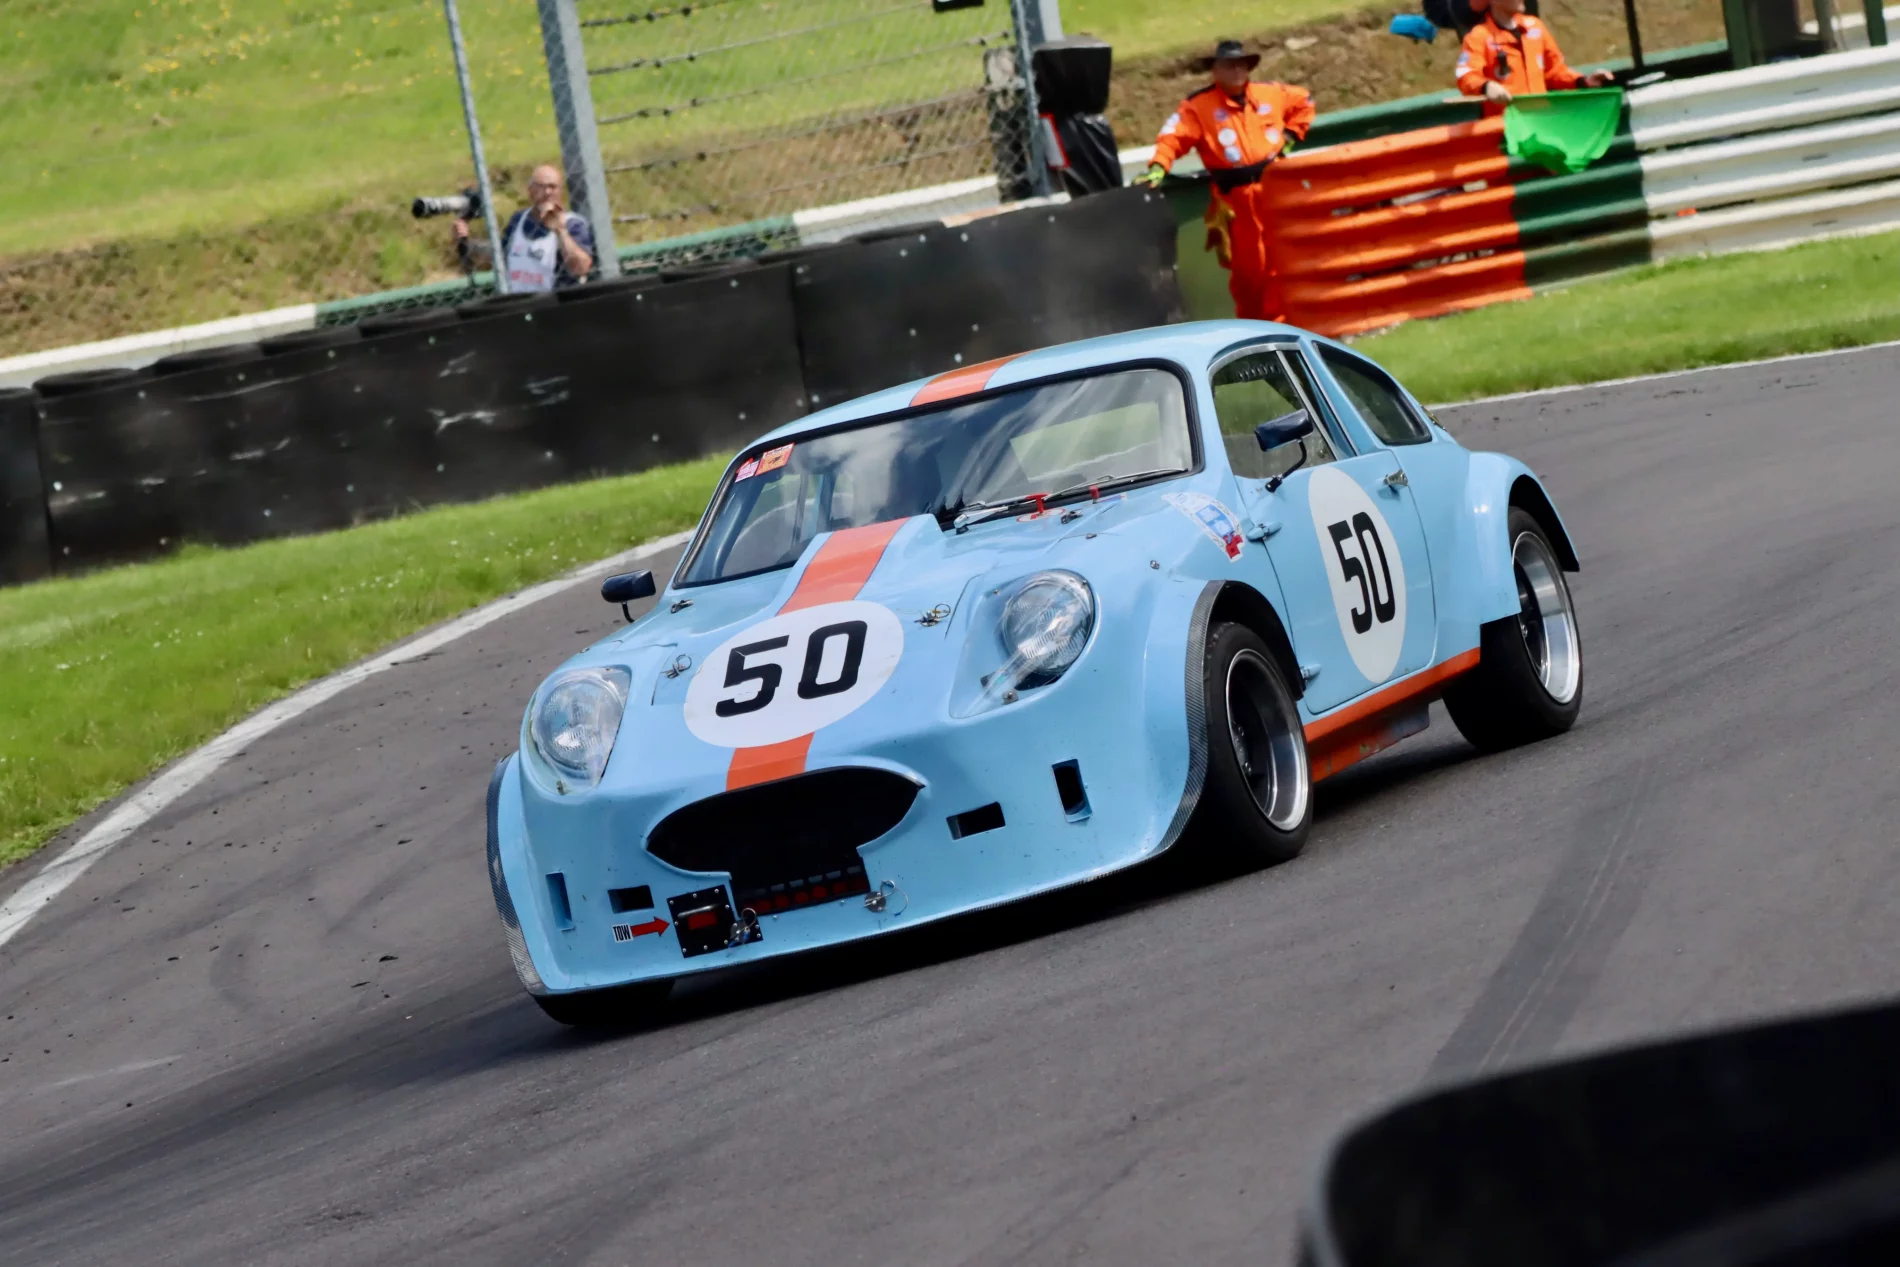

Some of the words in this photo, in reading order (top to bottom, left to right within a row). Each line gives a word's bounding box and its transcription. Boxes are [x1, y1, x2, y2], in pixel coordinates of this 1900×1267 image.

[1327, 512, 1396, 635] 50
[715, 620, 868, 718] 50
[612, 924, 632, 942] TOW
